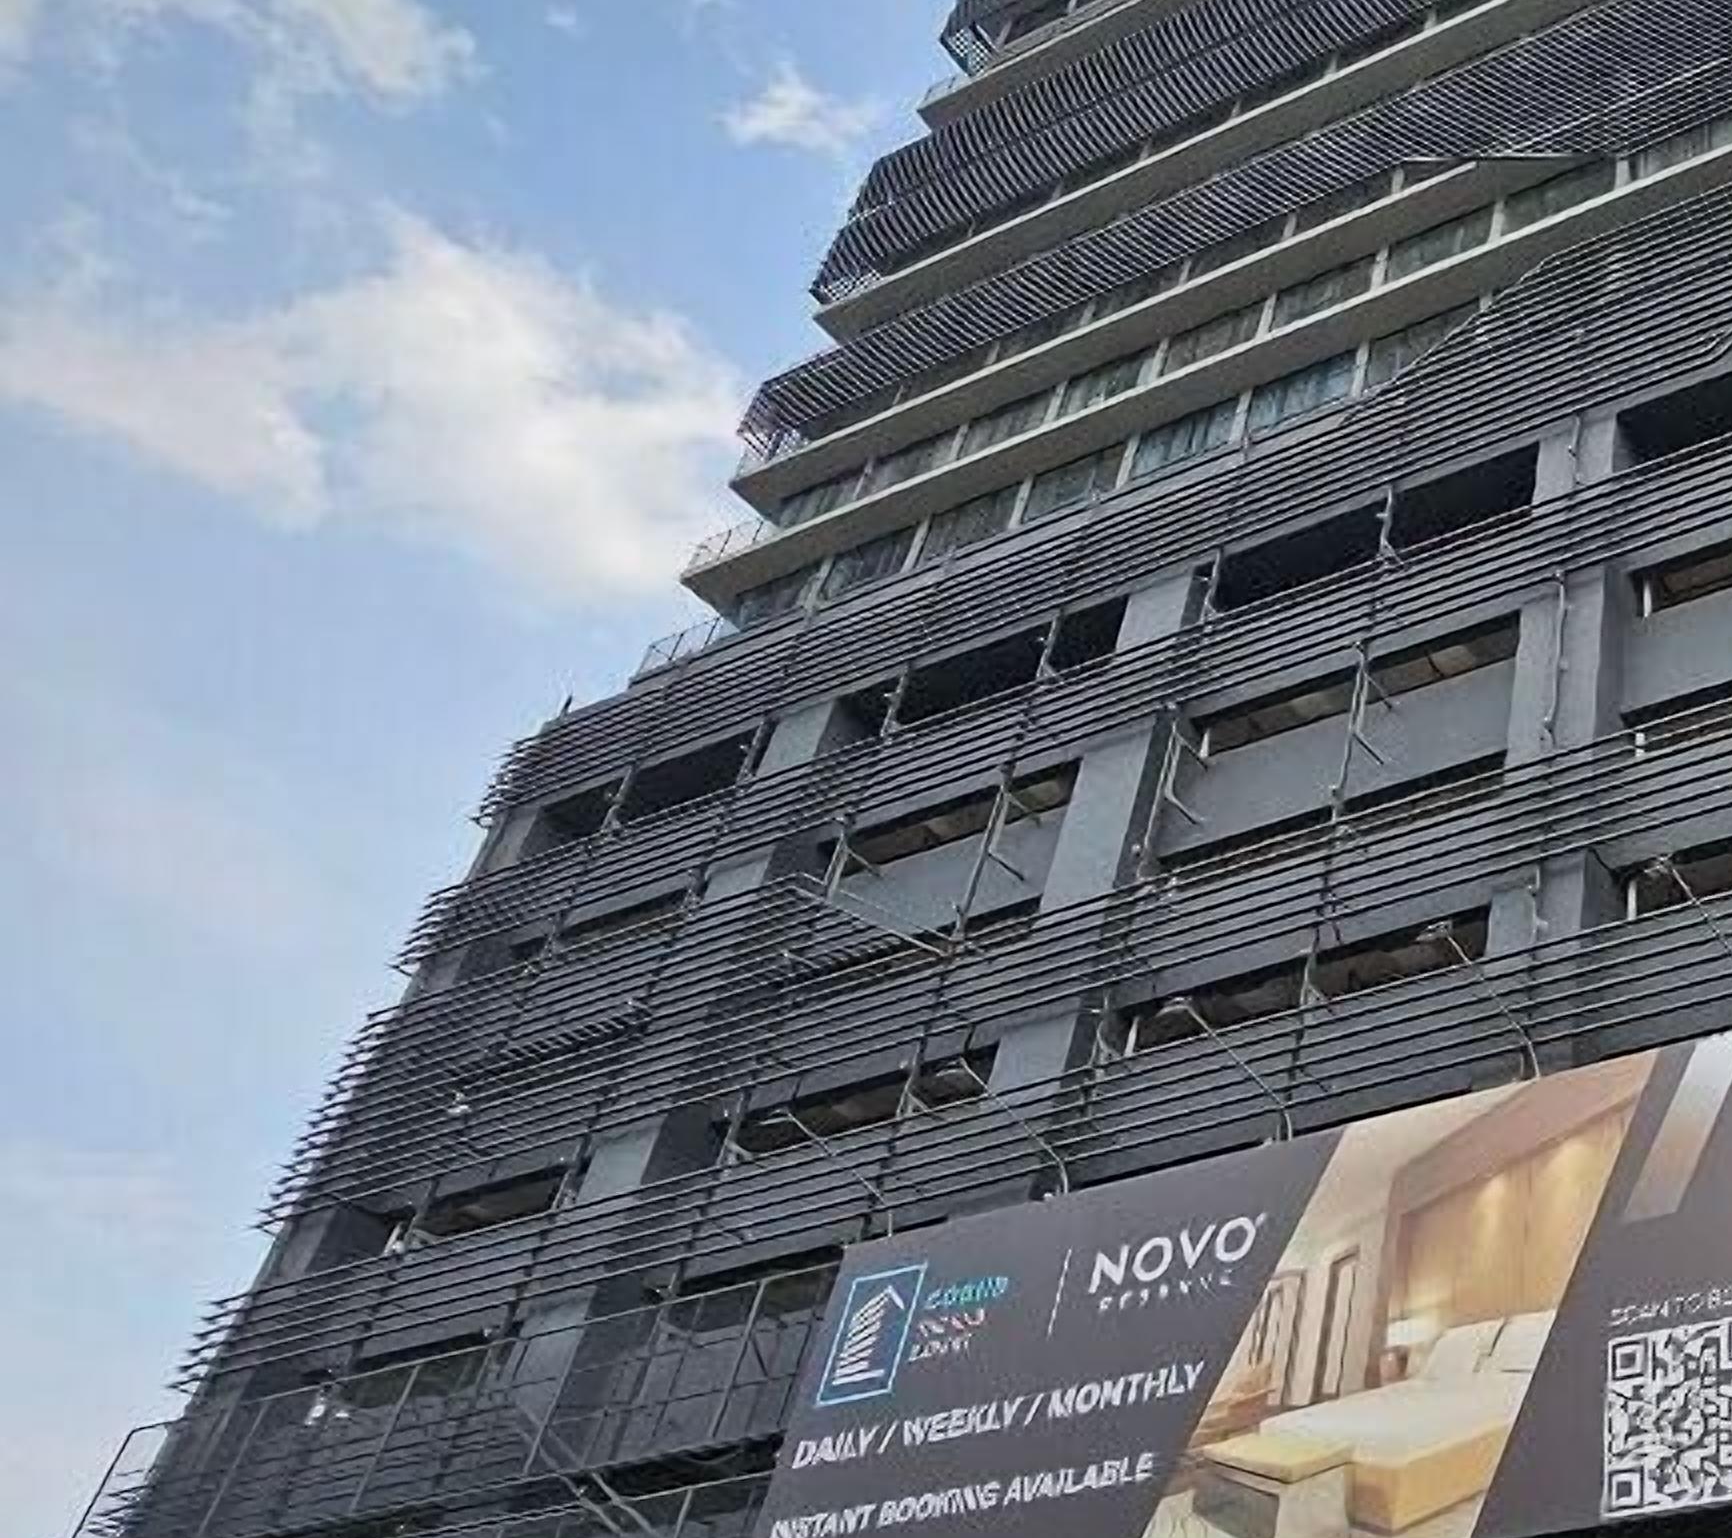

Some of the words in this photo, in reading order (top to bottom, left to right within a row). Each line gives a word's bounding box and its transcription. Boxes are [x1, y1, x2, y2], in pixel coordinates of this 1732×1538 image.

[1088, 1216, 1257, 1294] NOVO
[791, 1424, 880, 1470] DAILY
[902, 1395, 1024, 1447] WEEKLY
[1046, 1361, 1206, 1419] MONTHLY
[874, 1480, 1001, 1529] BOOKING
[1002, 1452, 1155, 1508] AVAILABLE
